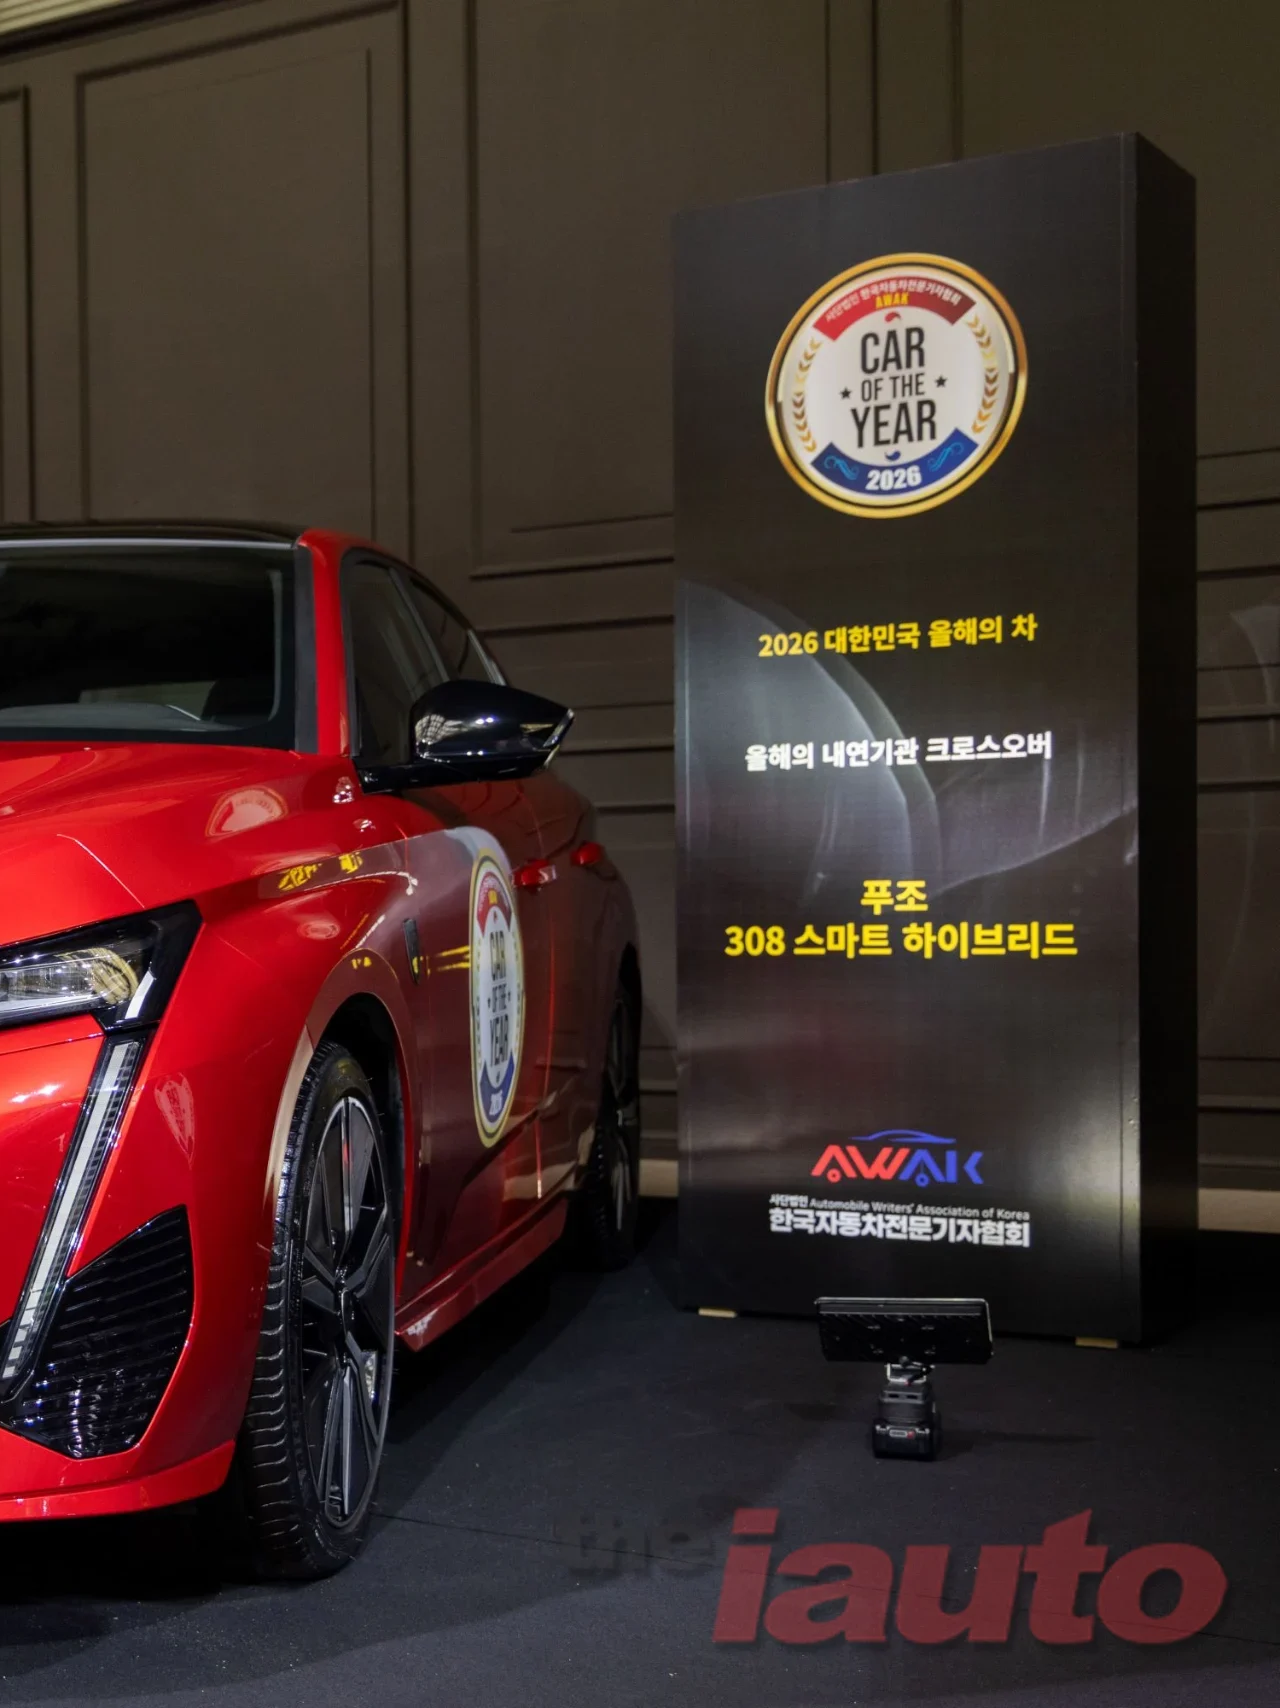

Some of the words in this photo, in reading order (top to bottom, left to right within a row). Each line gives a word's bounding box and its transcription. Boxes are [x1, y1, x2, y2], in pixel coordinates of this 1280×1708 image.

[875, 291, 910, 309] AWAK
[860, 326, 926, 375] CAR
[860, 379, 884, 402] OF
[891, 373, 926, 400] THE
[851, 399, 938, 449] YEAR
[865, 465, 923, 491] 2026
[758, 631, 819, 657] 2026
[824, 622, 921, 654] 대한민국
[927, 616, 1003, 648] 올해의
[1011, 613, 1038, 642] 차
[745, 742, 814, 772] 올해의
[821, 737, 919, 769] 내연기관
[925, 730, 1053, 762] 크로스오버
[860, 879, 928, 915] 푸조
[724, 925, 786, 957] 308
[793, 922, 893, 959] 스마트
[902, 921, 1078, 960] 하이브리드
[810, 1144, 984, 1187] AWAK
[769, 1207, 1031, 1248] 한국자동차전문기자협회
[810, 1198, 870, 1212] Automobile
[916, 1204, 980, 1218] Association
[982, 1207, 995, 1218] of
[996, 1209, 1031, 1221] Korea
